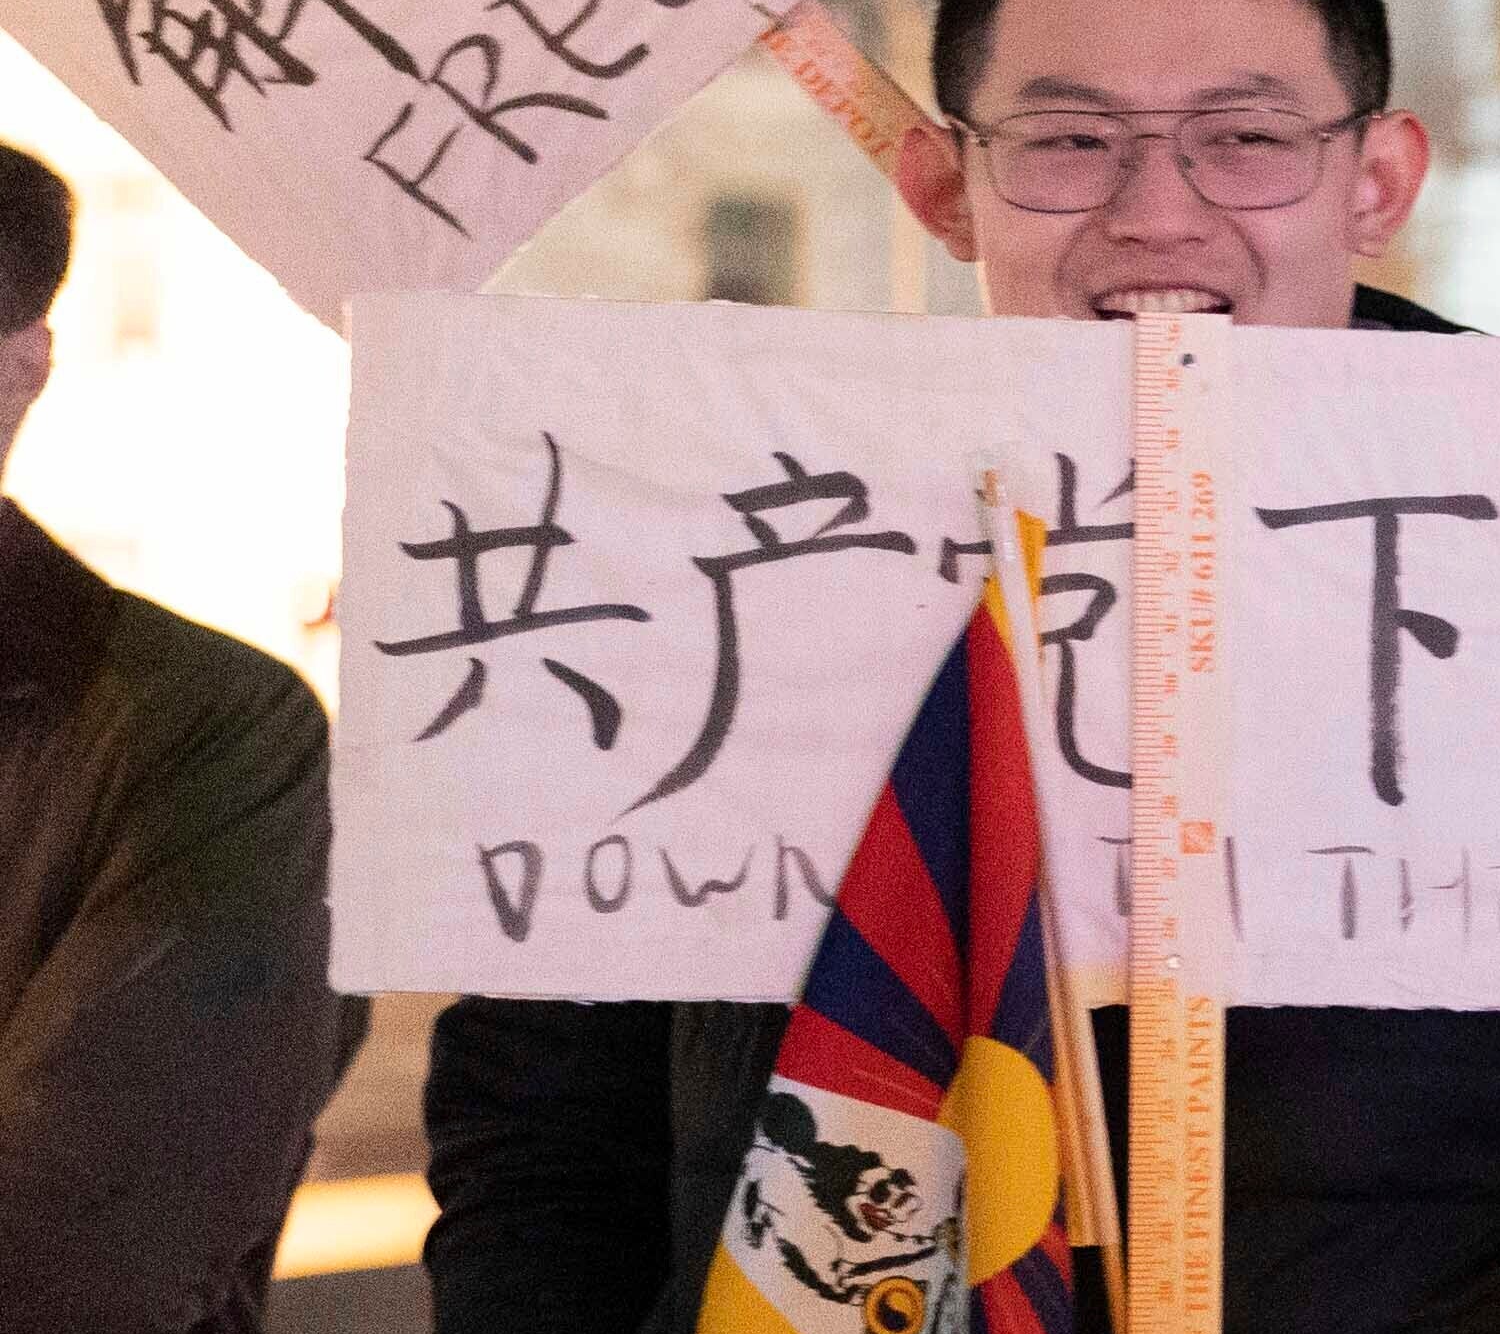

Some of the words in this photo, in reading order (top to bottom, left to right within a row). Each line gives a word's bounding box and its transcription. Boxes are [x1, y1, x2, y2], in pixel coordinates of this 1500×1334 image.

[1189, 470, 1215, 521] 269
[1189, 533, 1215, 581] 611
[1186, 995, 1213, 1116] PAINTS
[1185, 1124, 1212, 1242] FINEST
[1184, 1248, 1210, 1318] THE
